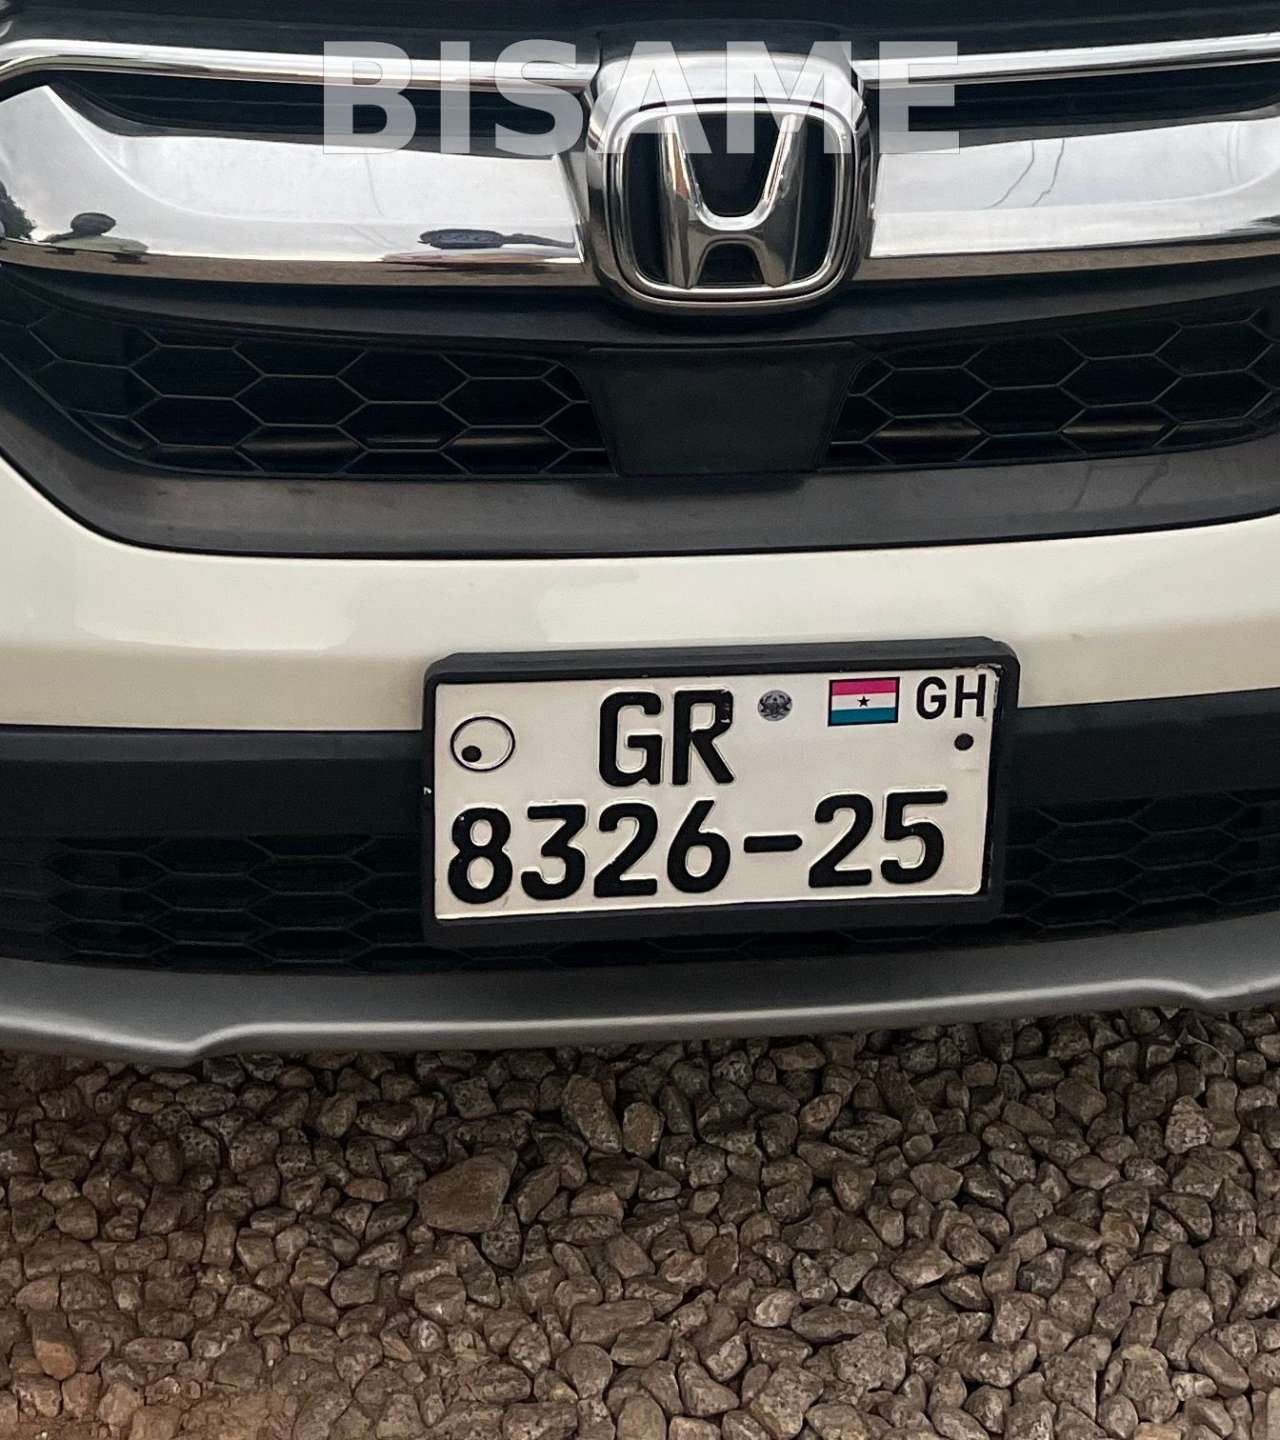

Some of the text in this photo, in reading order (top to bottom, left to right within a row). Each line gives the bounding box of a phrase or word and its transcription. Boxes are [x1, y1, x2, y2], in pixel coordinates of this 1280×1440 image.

[598, 688, 735, 787] GR
[915, 673, 987, 721] GH
[447, 790, 949, 904] 8326-25
